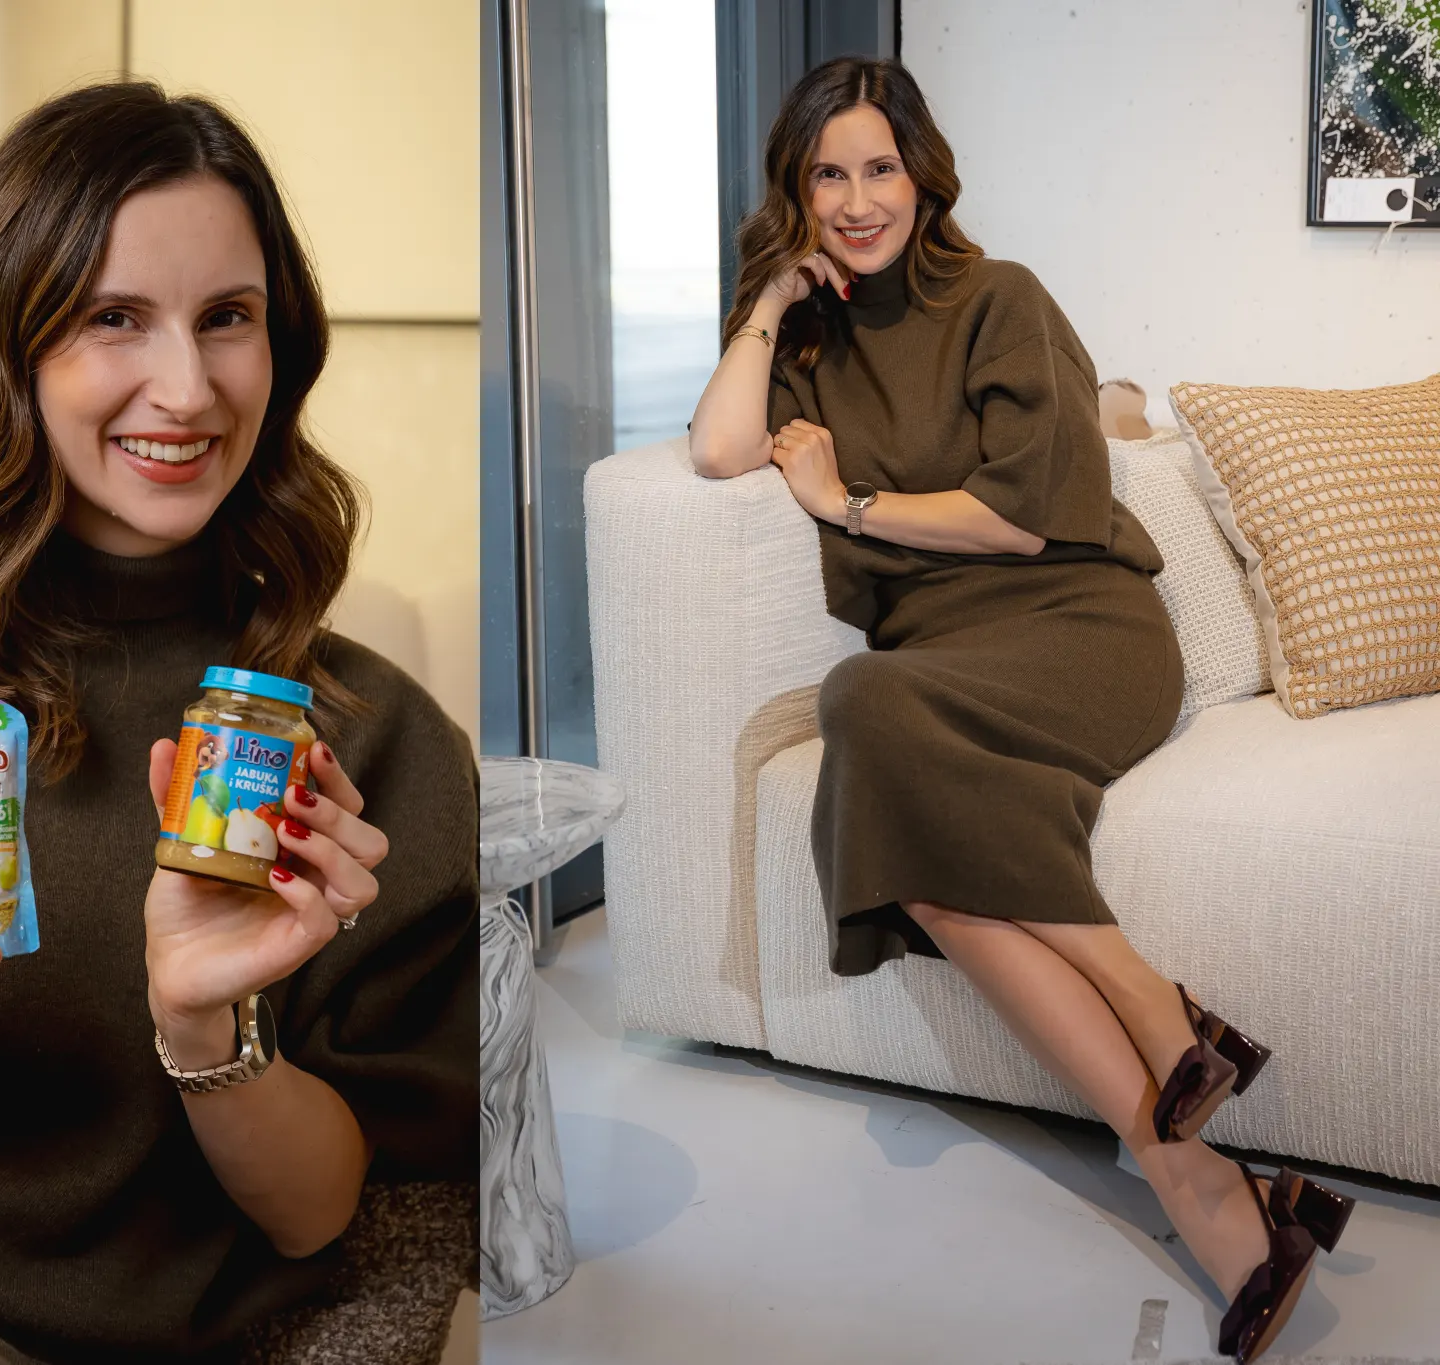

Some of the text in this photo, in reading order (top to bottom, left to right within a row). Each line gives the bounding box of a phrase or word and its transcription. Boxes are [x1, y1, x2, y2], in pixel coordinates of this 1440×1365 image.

[233, 736, 288, 770] Lino
[235, 766, 278, 784] JABUKA
[235, 778, 279, 797] KRUŠKA
